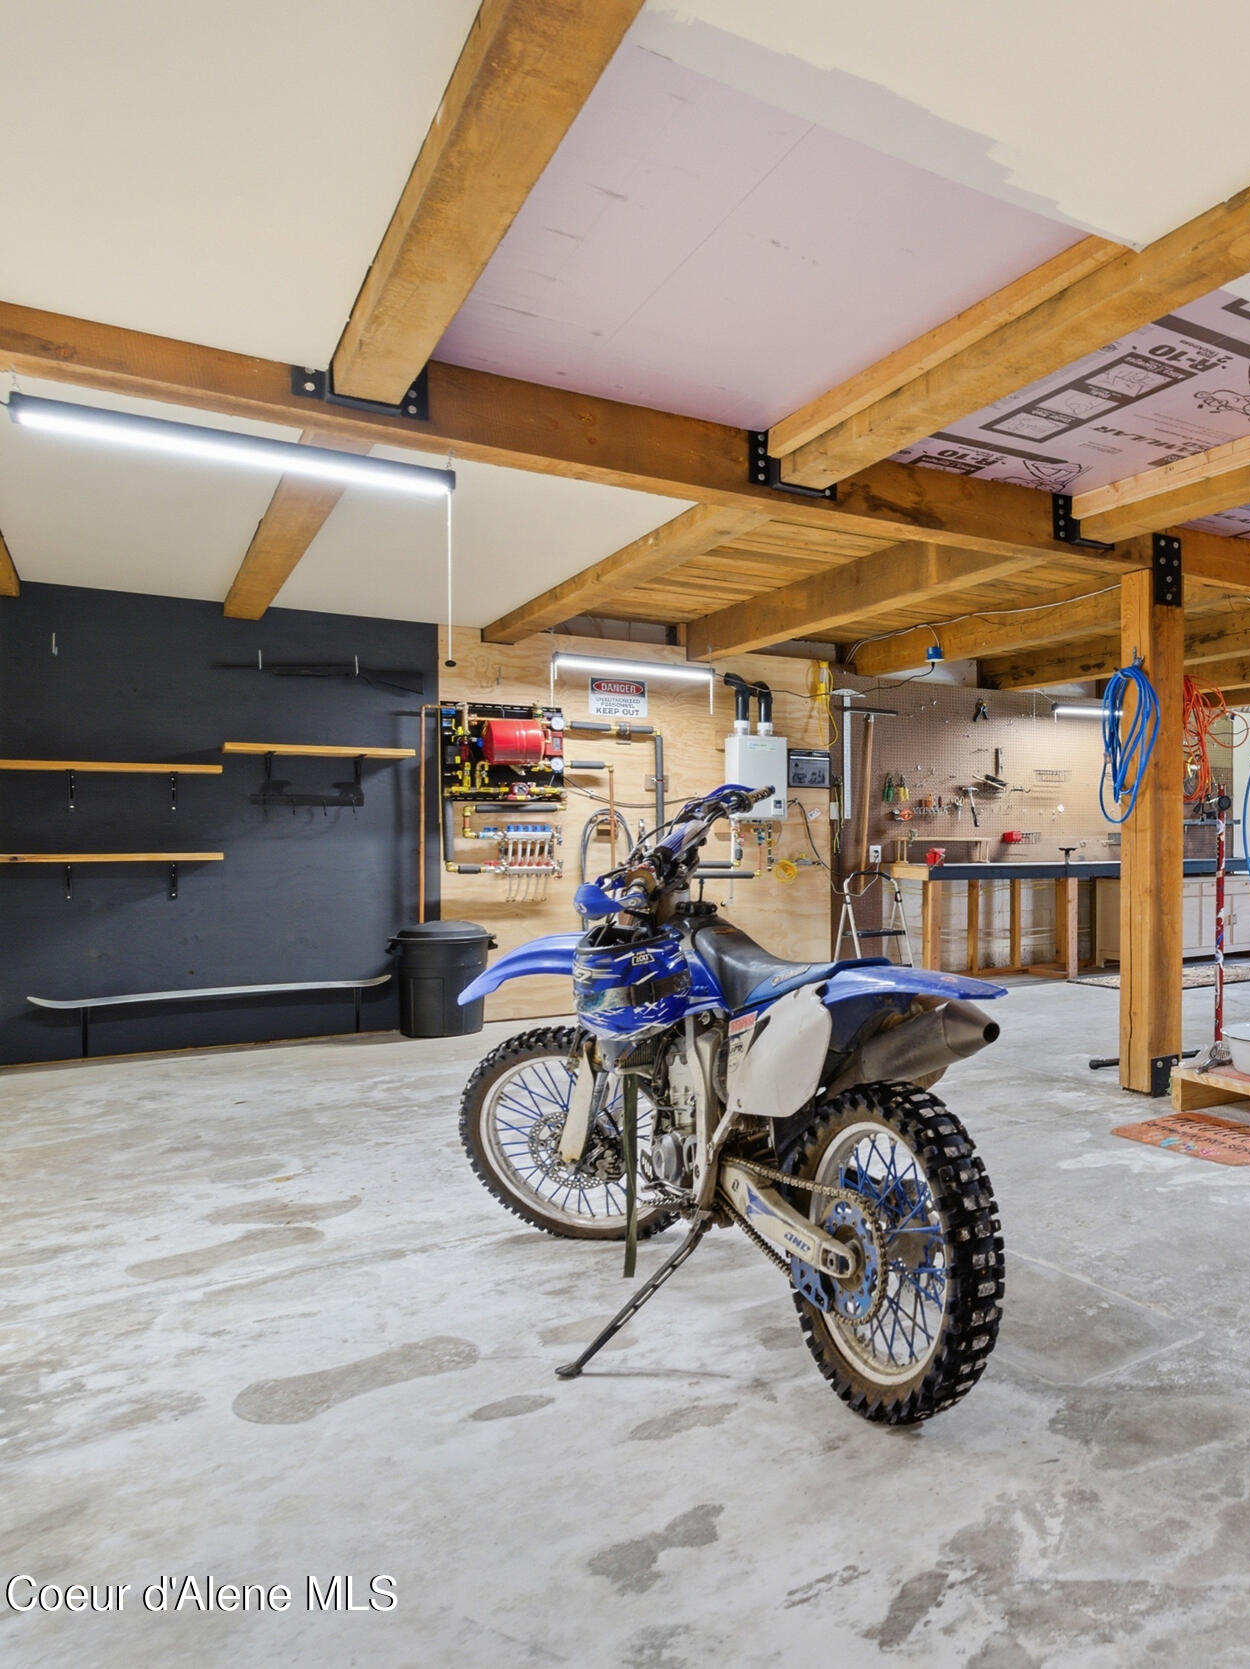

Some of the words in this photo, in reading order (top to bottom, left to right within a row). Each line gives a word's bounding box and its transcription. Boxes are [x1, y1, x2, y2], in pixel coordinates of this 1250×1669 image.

[1147, 344, 1221, 373] R-10
[936, 449, 999, 467] R-10
[601, 682, 636, 694] DANGER
[596, 707, 620, 715] KEEP
[621, 708, 641, 716] OUT
